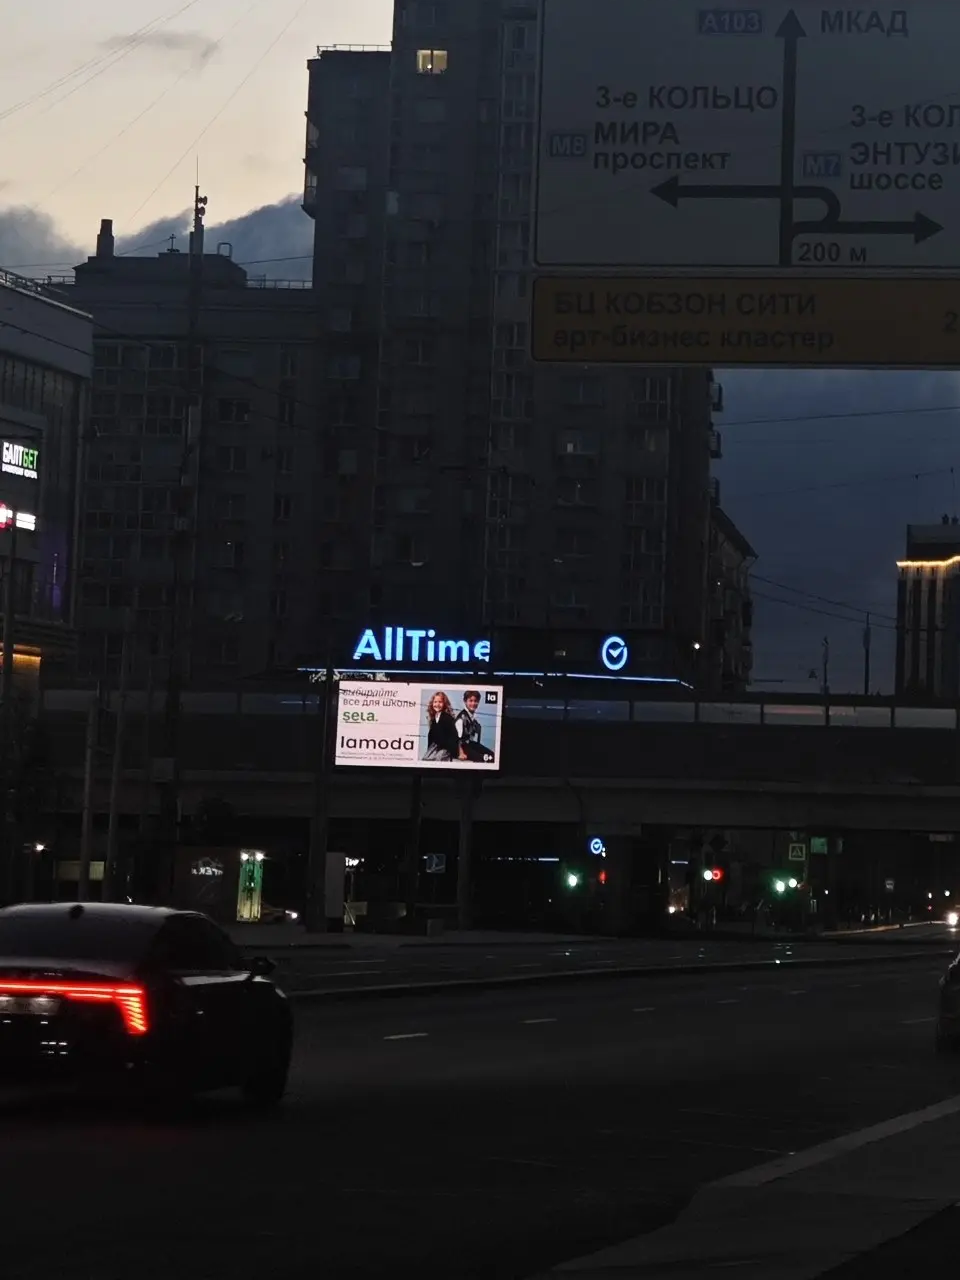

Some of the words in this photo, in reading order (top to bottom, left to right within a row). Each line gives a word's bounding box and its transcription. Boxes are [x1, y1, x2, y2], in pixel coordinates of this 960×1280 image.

[702, 12, 761, 33] А103
[821, 11, 908, 37] МКАД
[596, 86, 637, 109] 3-е
[648, 86, 778, 112] КОЛЬЦО
[850, 105, 892, 128] 3-е
[594, 122, 680, 146] МИРА
[593, 151, 730, 173] проспект
[849, 172, 943, 191] шоссе
[799, 243, 841, 263] 200
[849, 247, 867, 263] м
[554, 293, 597, 316] БЦ
[606, 292, 727, 315] КОБЗОН
[737, 292, 816, 315] СИТИ
[553, 328, 714, 354] арт-бизнес
[720, 329, 835, 353] кластер
[2, 441, 38, 470] БАЛТБЕТ
[353, 626, 491, 663] AllTime
[362, 699, 380, 708] для
[382, 699, 416, 708] школы
[340, 735, 414, 751] lamoda
